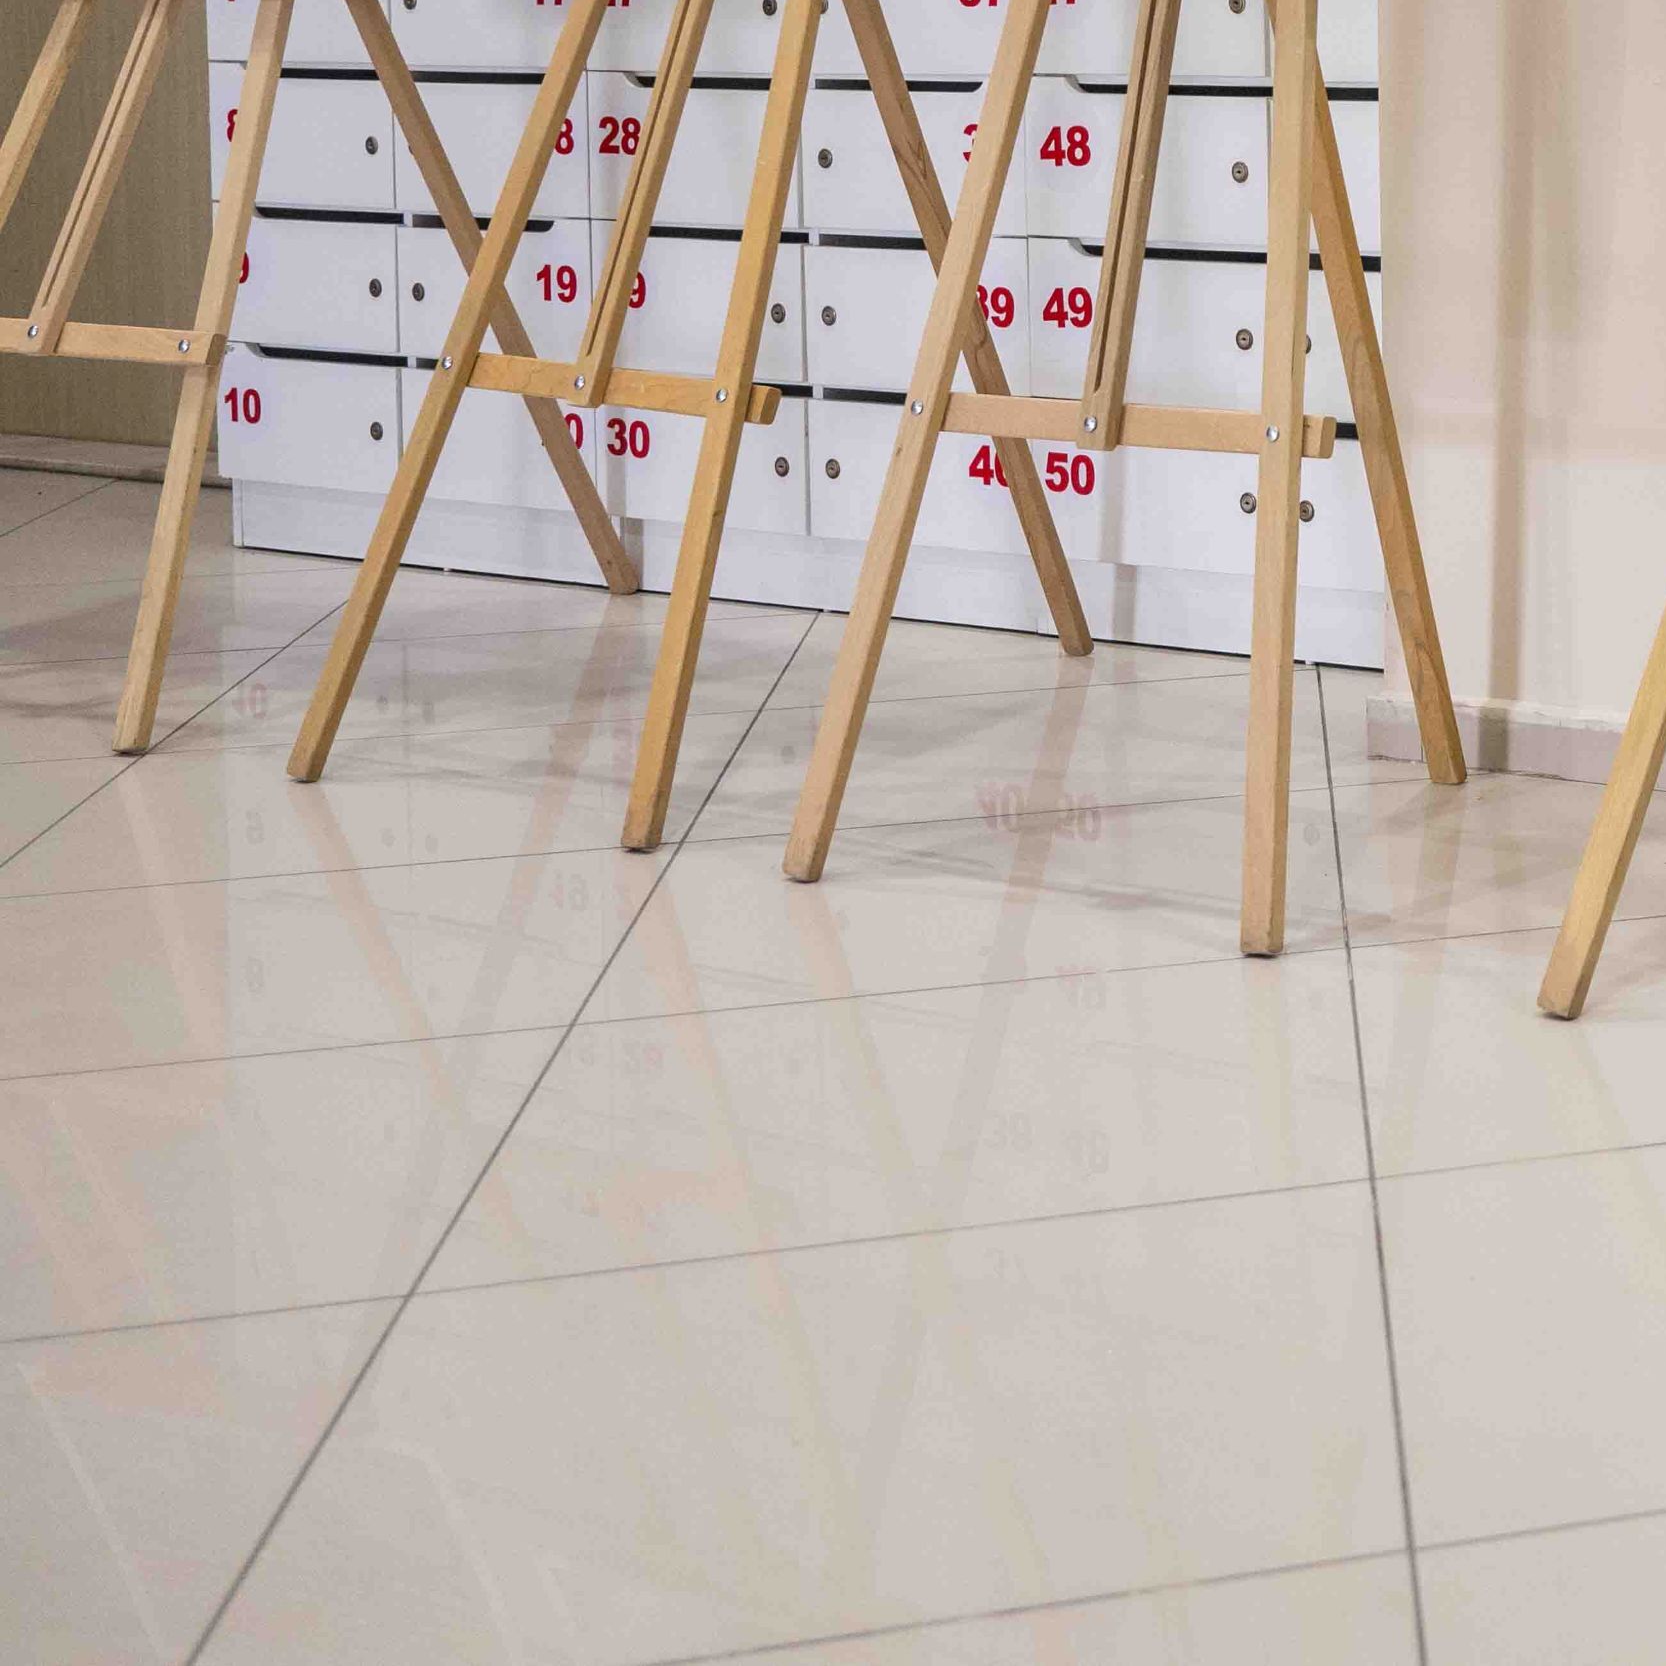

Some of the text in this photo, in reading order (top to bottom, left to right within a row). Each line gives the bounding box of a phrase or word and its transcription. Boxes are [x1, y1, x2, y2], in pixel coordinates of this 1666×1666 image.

[554, 118, 575, 155] 8
[599, 116, 643, 156] 28
[1039, 125, 1091, 167] 48
[536, 264, 577, 303] 19
[628, 272, 646, 309] 9
[1042, 287, 1093, 328] 49
[224, 387, 262, 424] 10
[607, 417, 651, 459] 30
[1045, 451, 1096, 496] 50
